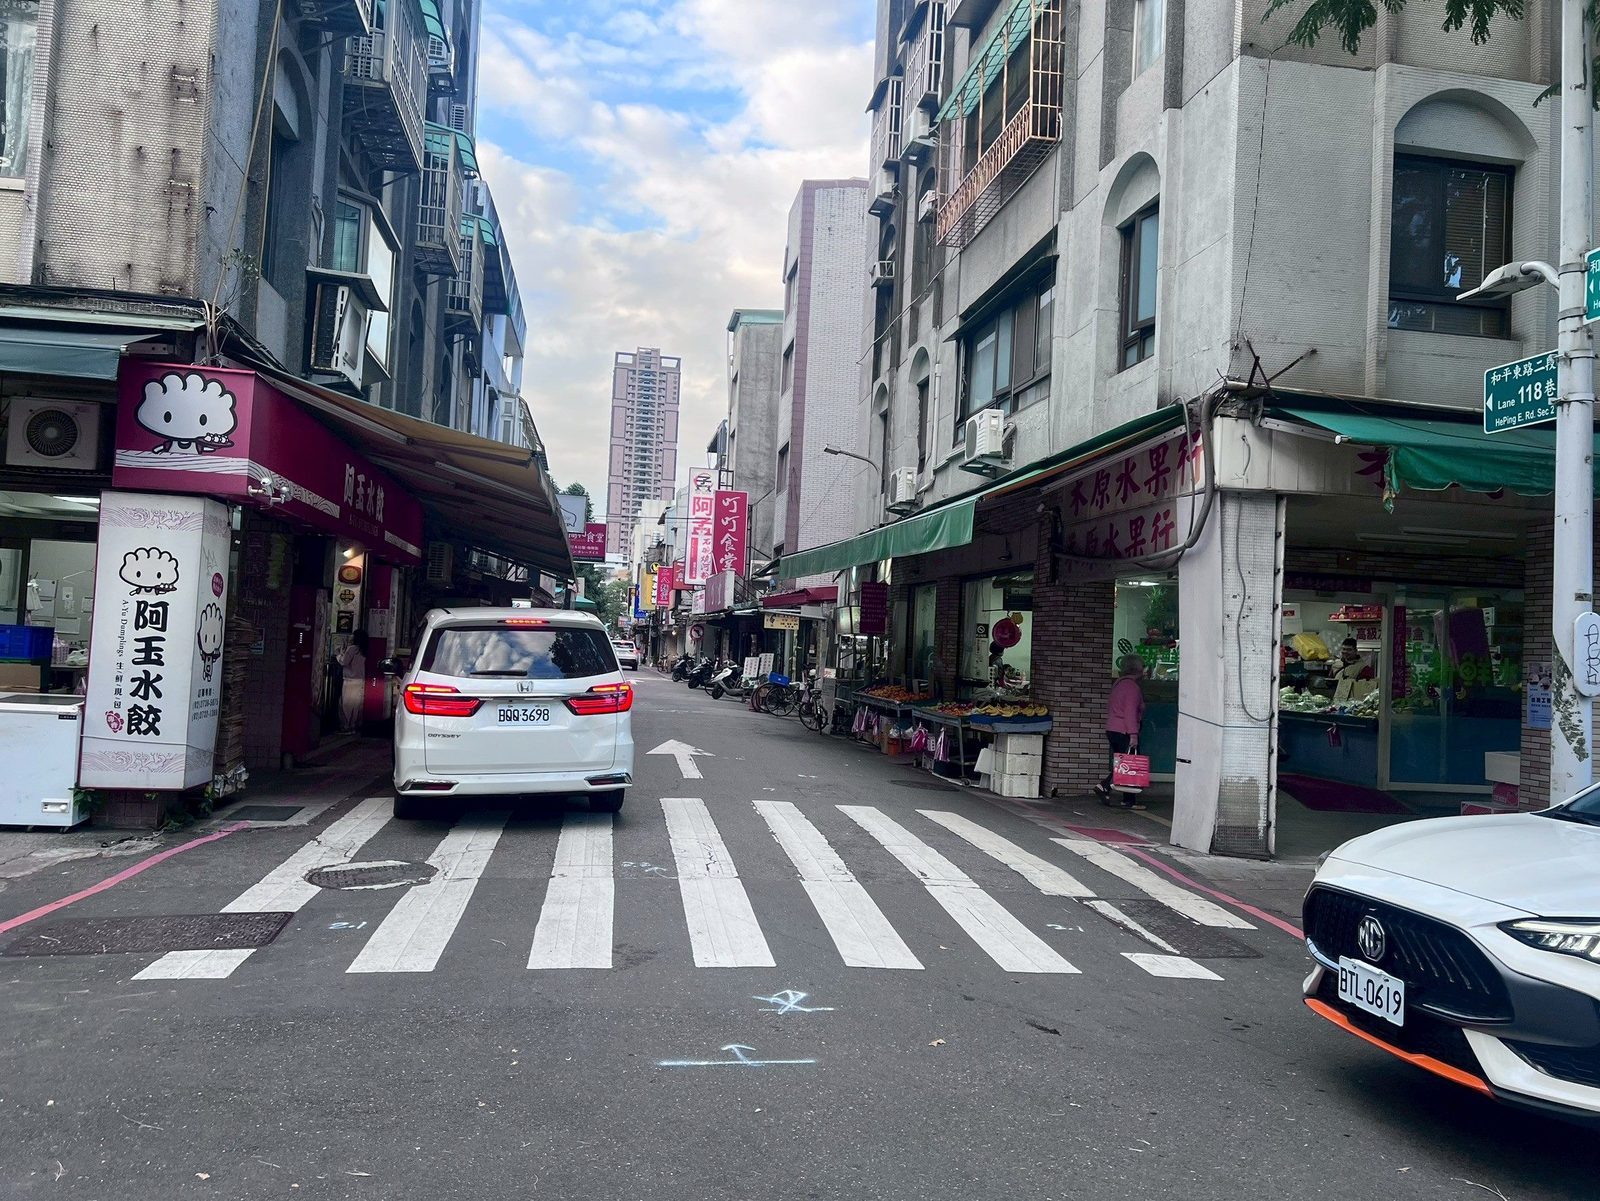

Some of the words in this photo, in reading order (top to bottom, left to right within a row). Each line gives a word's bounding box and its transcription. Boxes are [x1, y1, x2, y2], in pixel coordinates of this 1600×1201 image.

[1491, 358, 1557, 386] 和平東路二段
[1495, 413, 1517, 428] HePing
[1517, 411, 1525, 423] E.
[1525, 408, 1536, 421] Rd.
[1537, 406, 1550, 418] Sec
[1549, 406, 1555, 415] 2
[1498, 398, 1516, 410] Lane
[343, 463, 385, 524] 阿玉水餃
[720, 496, 741, 572] 叮叮食堂
[116, 618, 128, 658] Dumplings
[126, 600, 169, 737] 阿玉水餃
[498, 708, 550, 722] BQQ-3698
[1360, 919, 1382, 957] MG
[1340, 968, 1402, 1016] BTL-0619
